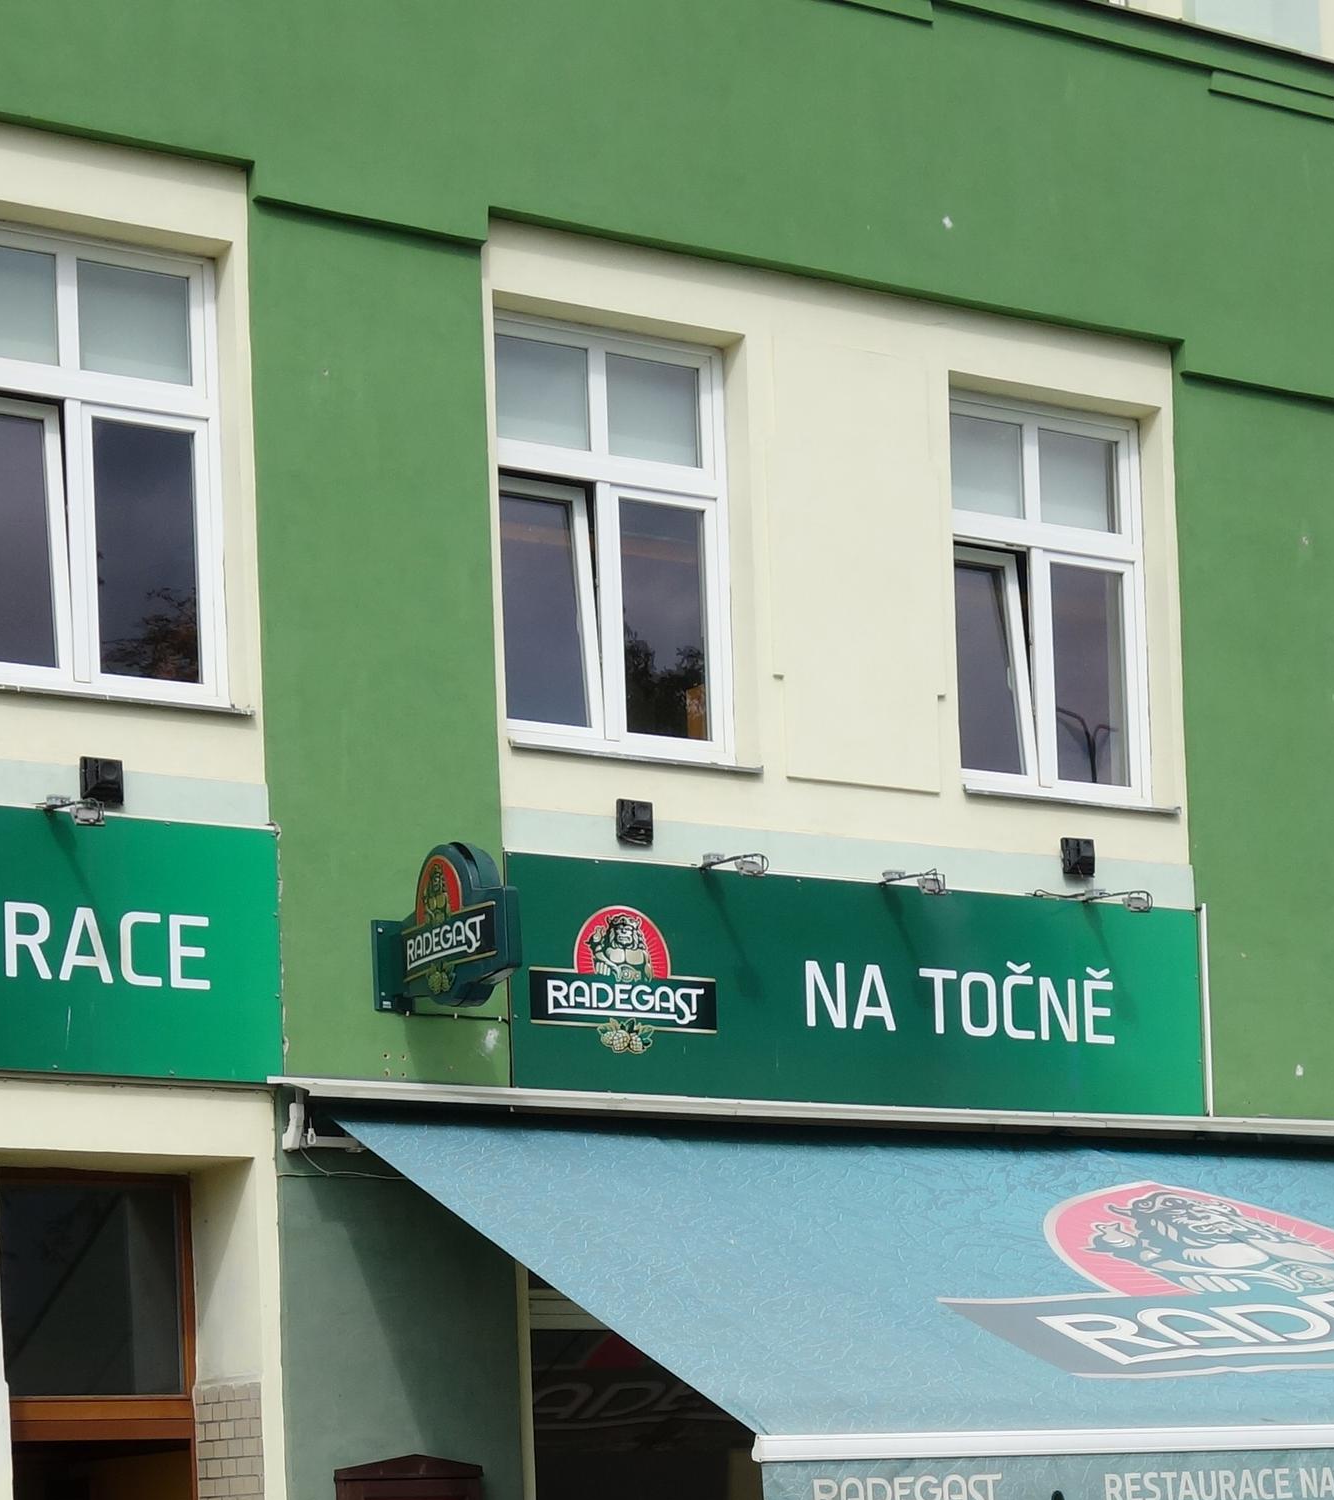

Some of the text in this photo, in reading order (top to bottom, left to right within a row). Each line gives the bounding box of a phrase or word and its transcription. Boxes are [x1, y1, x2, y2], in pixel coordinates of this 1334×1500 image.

[407, 914, 485, 970] RADEGAST
[547, 979, 704, 1024] RADEGAST
[805, 960, 1115, 1044] NA TOČNĚ
